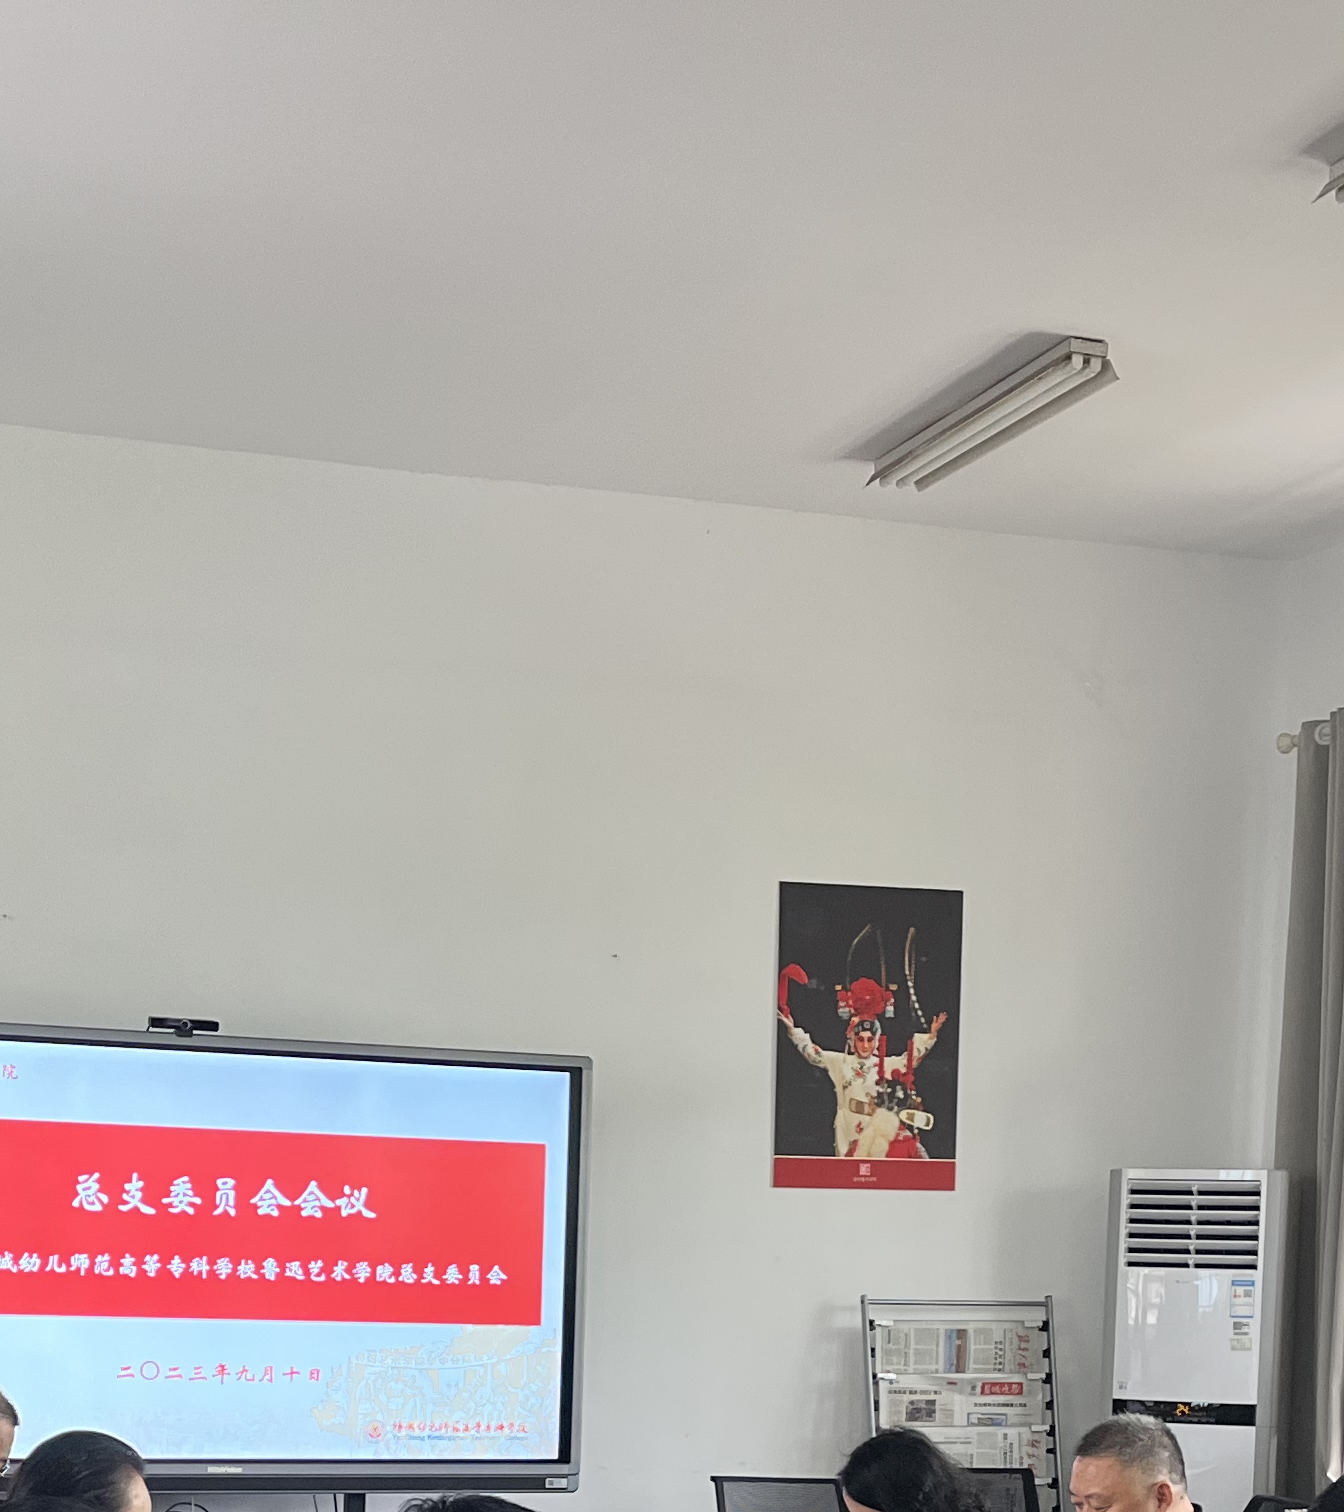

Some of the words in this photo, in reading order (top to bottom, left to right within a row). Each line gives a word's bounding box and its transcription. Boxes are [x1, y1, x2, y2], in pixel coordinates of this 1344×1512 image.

[71, 1171, 377, 1219] 总支委员会会议
